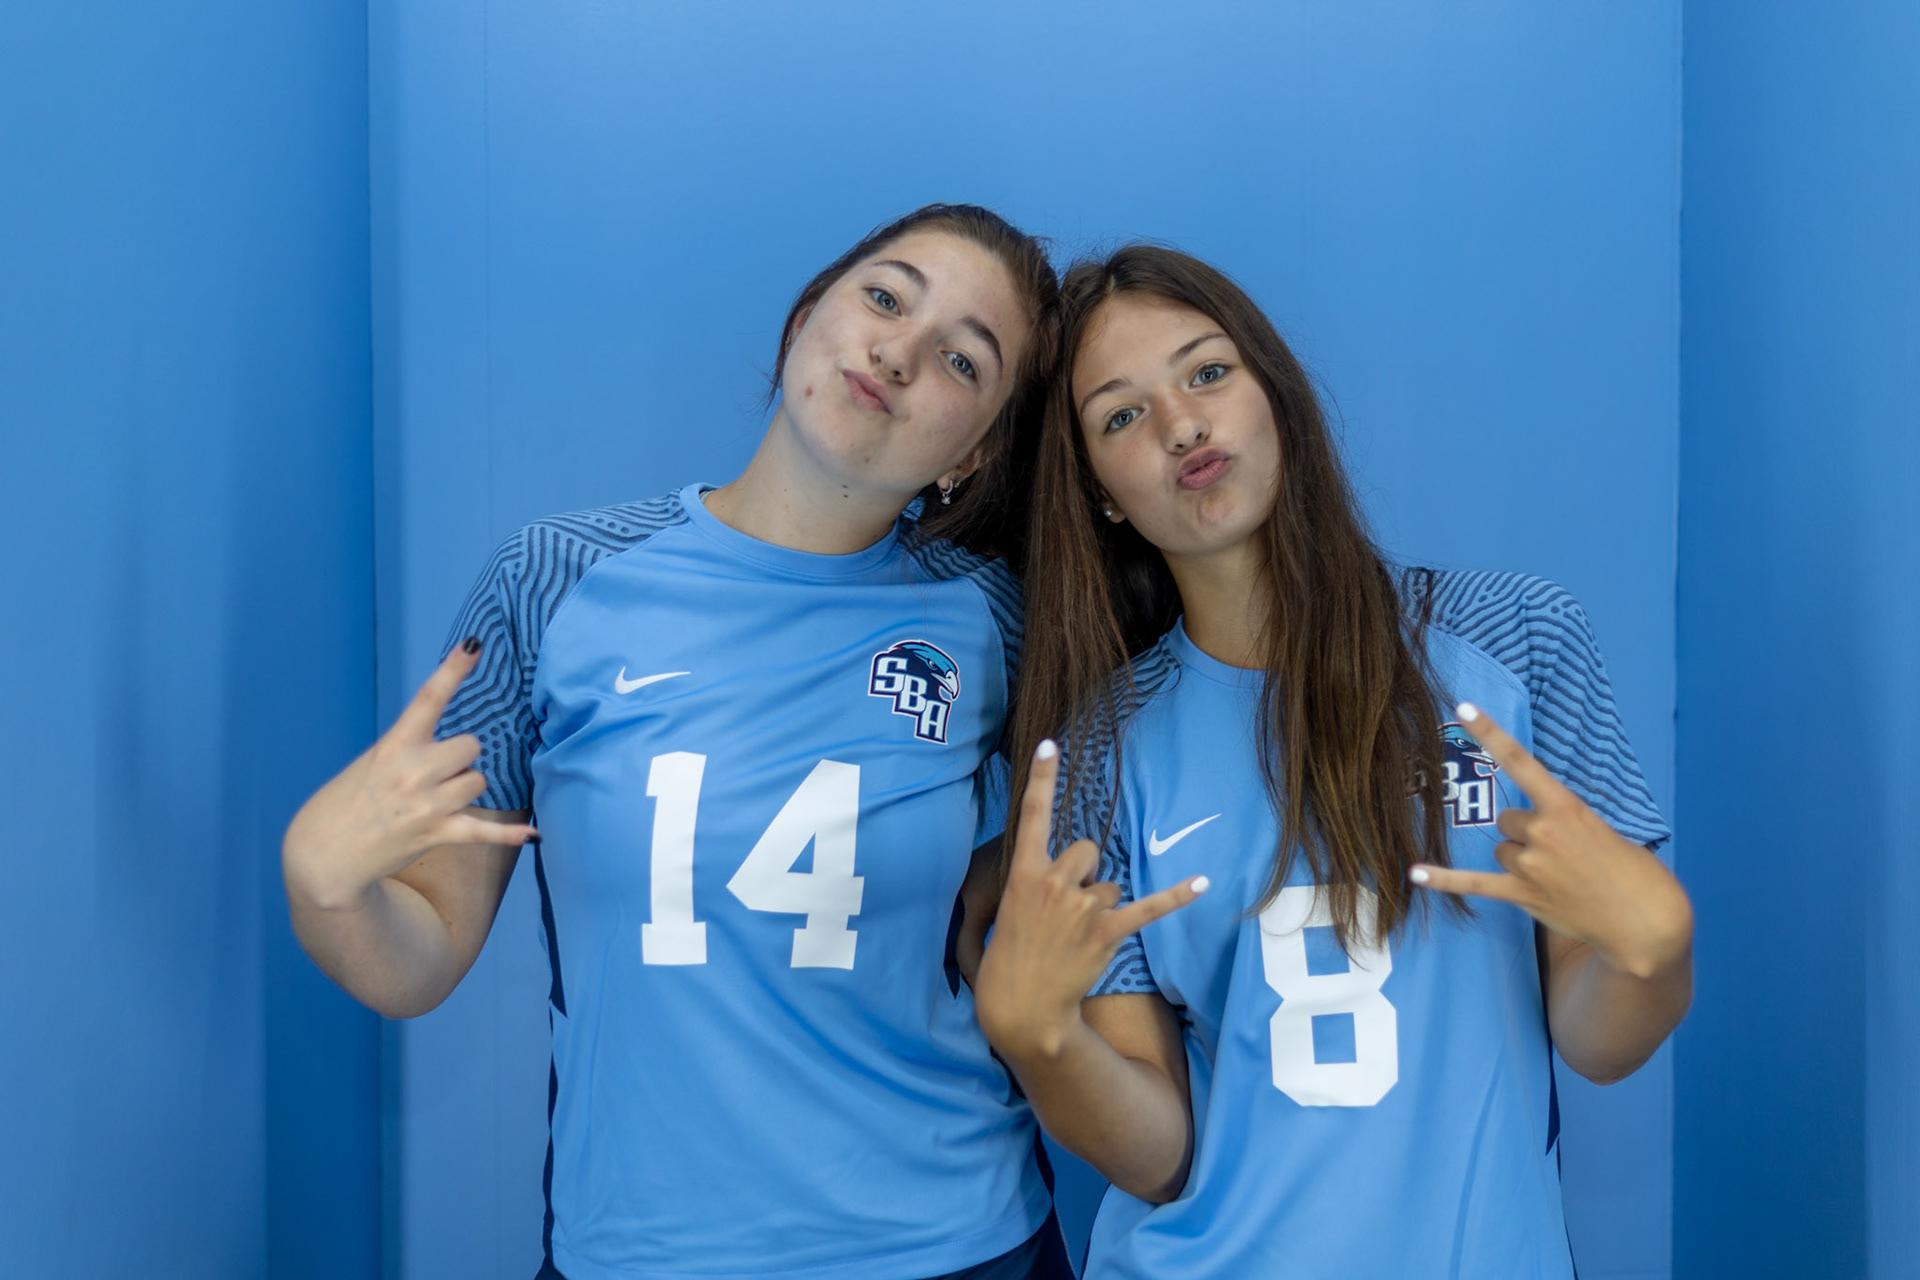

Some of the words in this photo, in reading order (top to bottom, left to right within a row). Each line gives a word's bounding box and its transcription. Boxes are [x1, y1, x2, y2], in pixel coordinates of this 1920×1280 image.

[874, 657, 949, 740] SBA
[642, 751, 865, 970] 14
[1259, 884, 1399, 1107] 8
